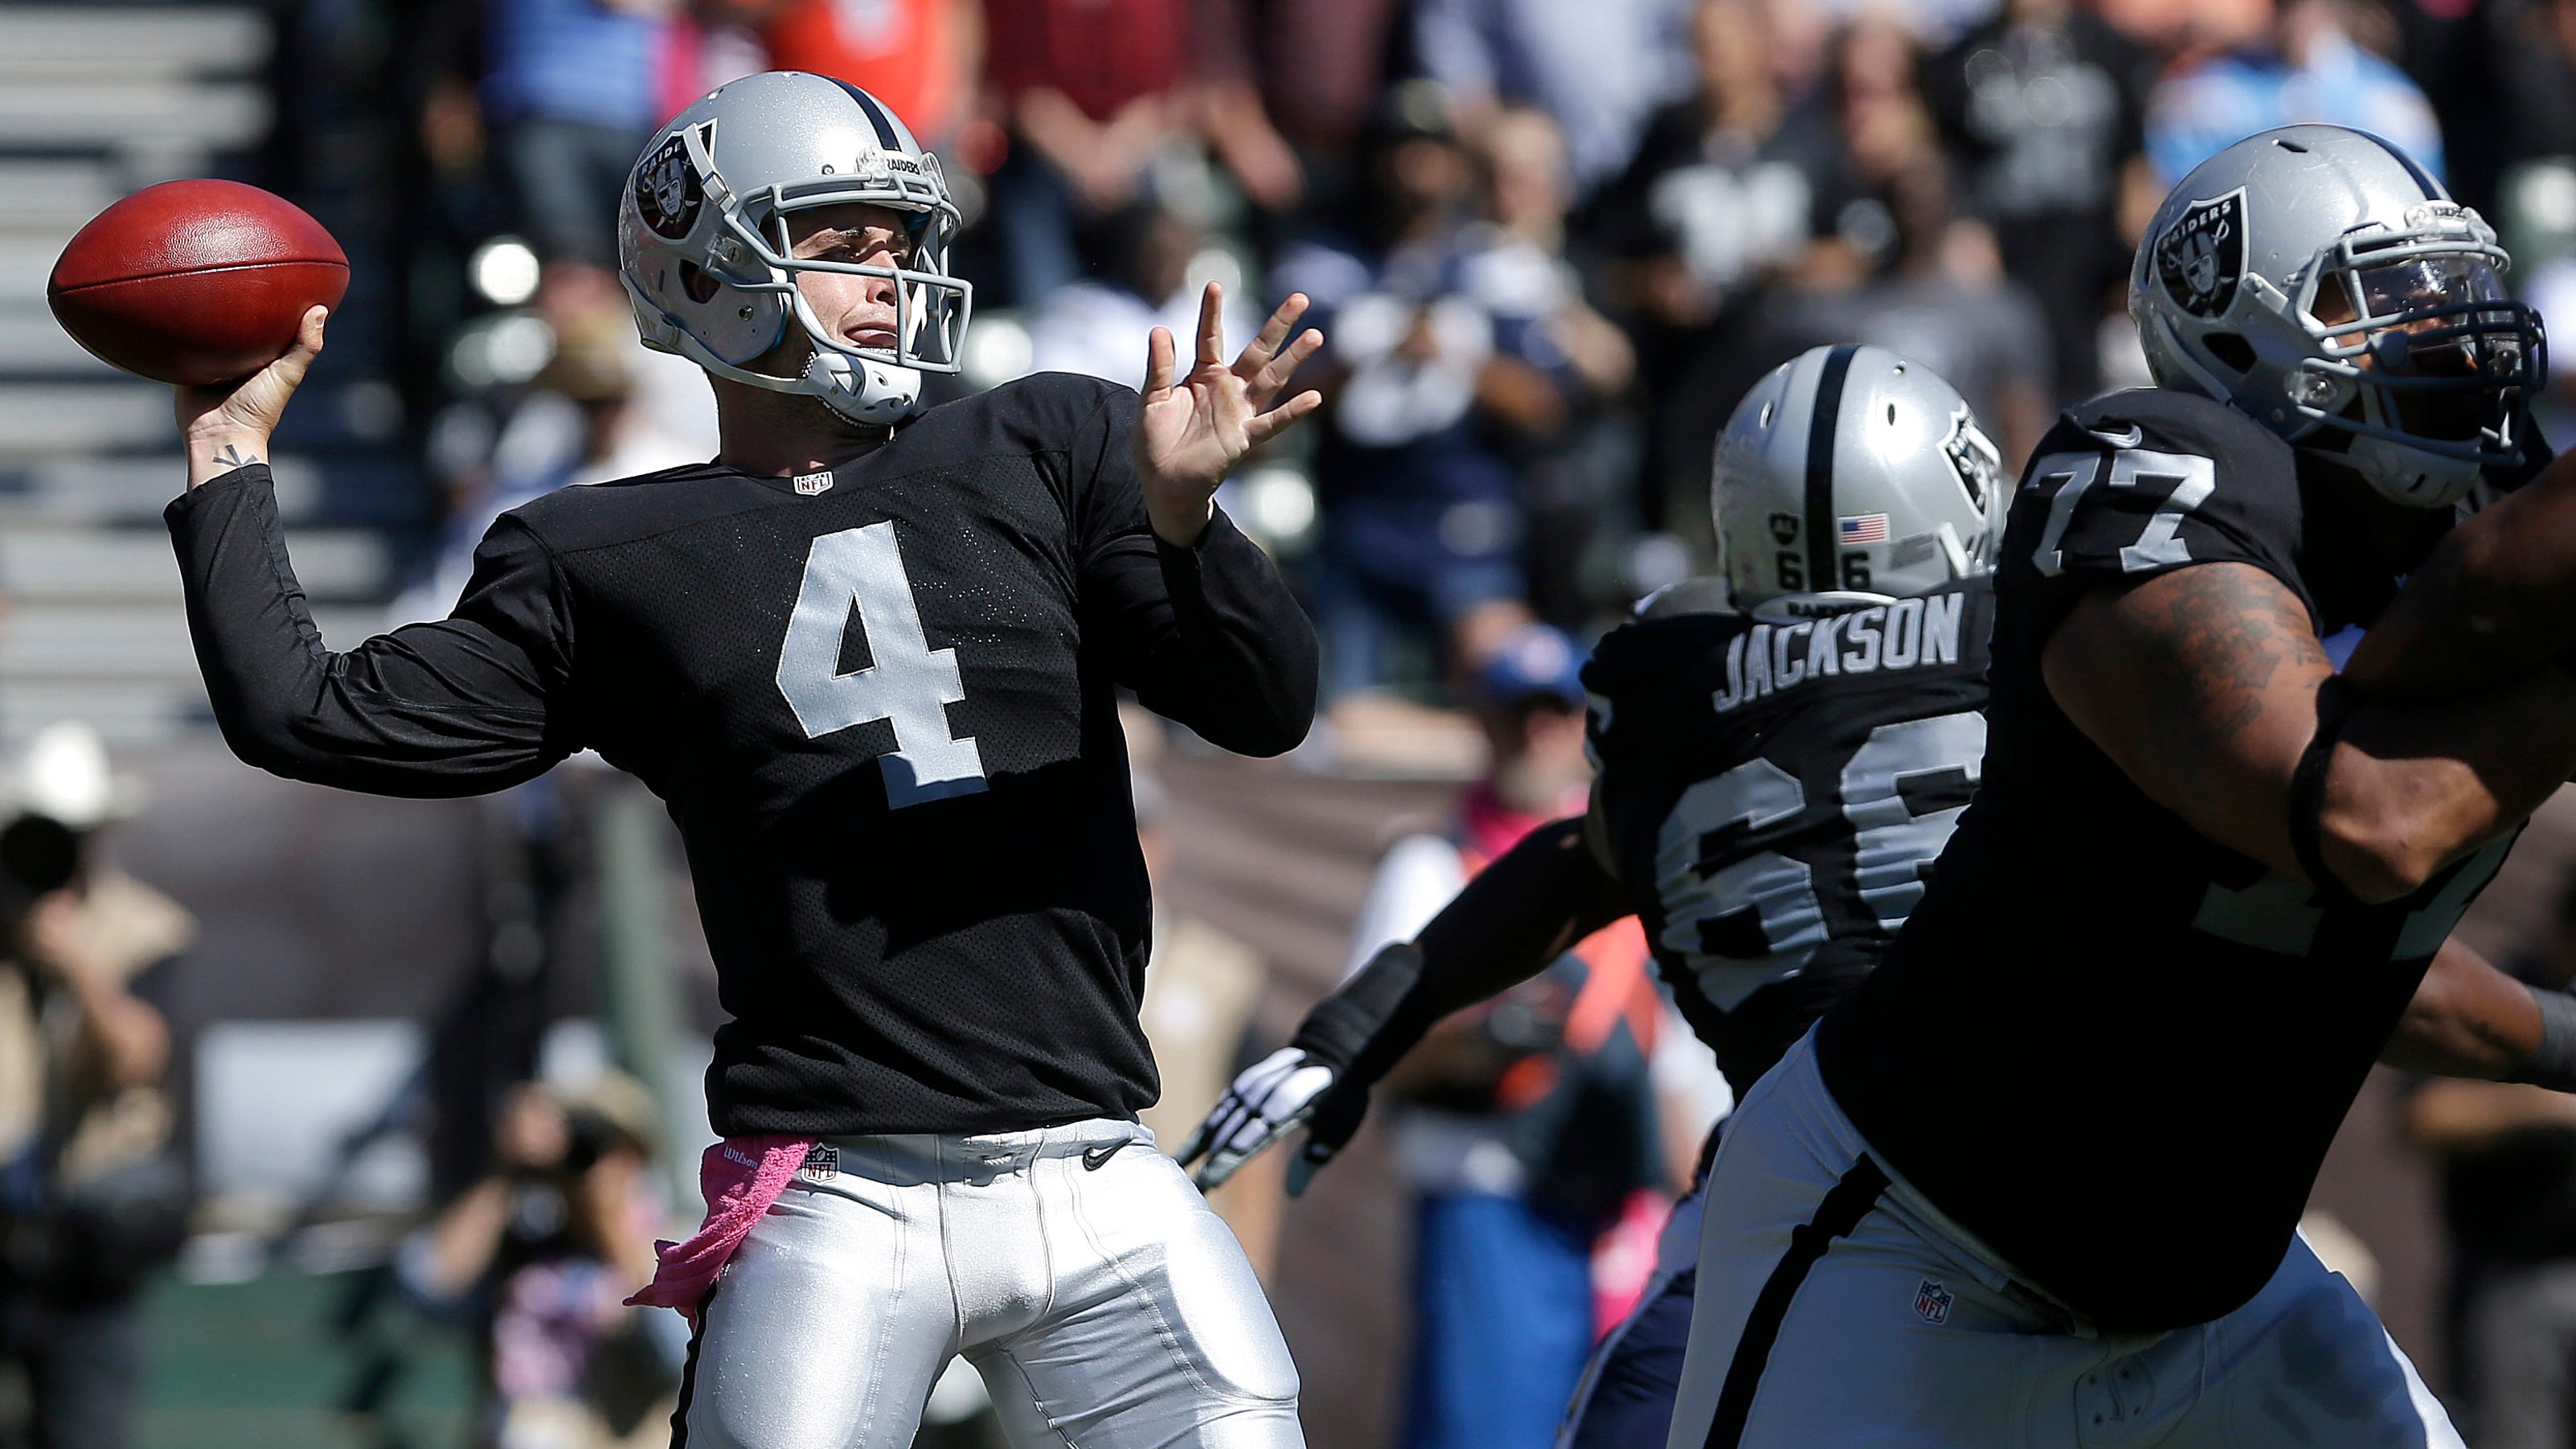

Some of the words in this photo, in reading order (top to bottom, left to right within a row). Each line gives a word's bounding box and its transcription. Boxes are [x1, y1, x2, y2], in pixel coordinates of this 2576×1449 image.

[801, 478, 827, 492] NFL
[2024, 450, 2217, 578] 77
[776, 520, 988, 809] 4
[1711, 593, 1964, 712] JACKSON
[723, 1146, 759, 1170] Wilson
[808, 1163, 833, 1179] NFL
[1918, 1296, 1943, 1320] NFL
